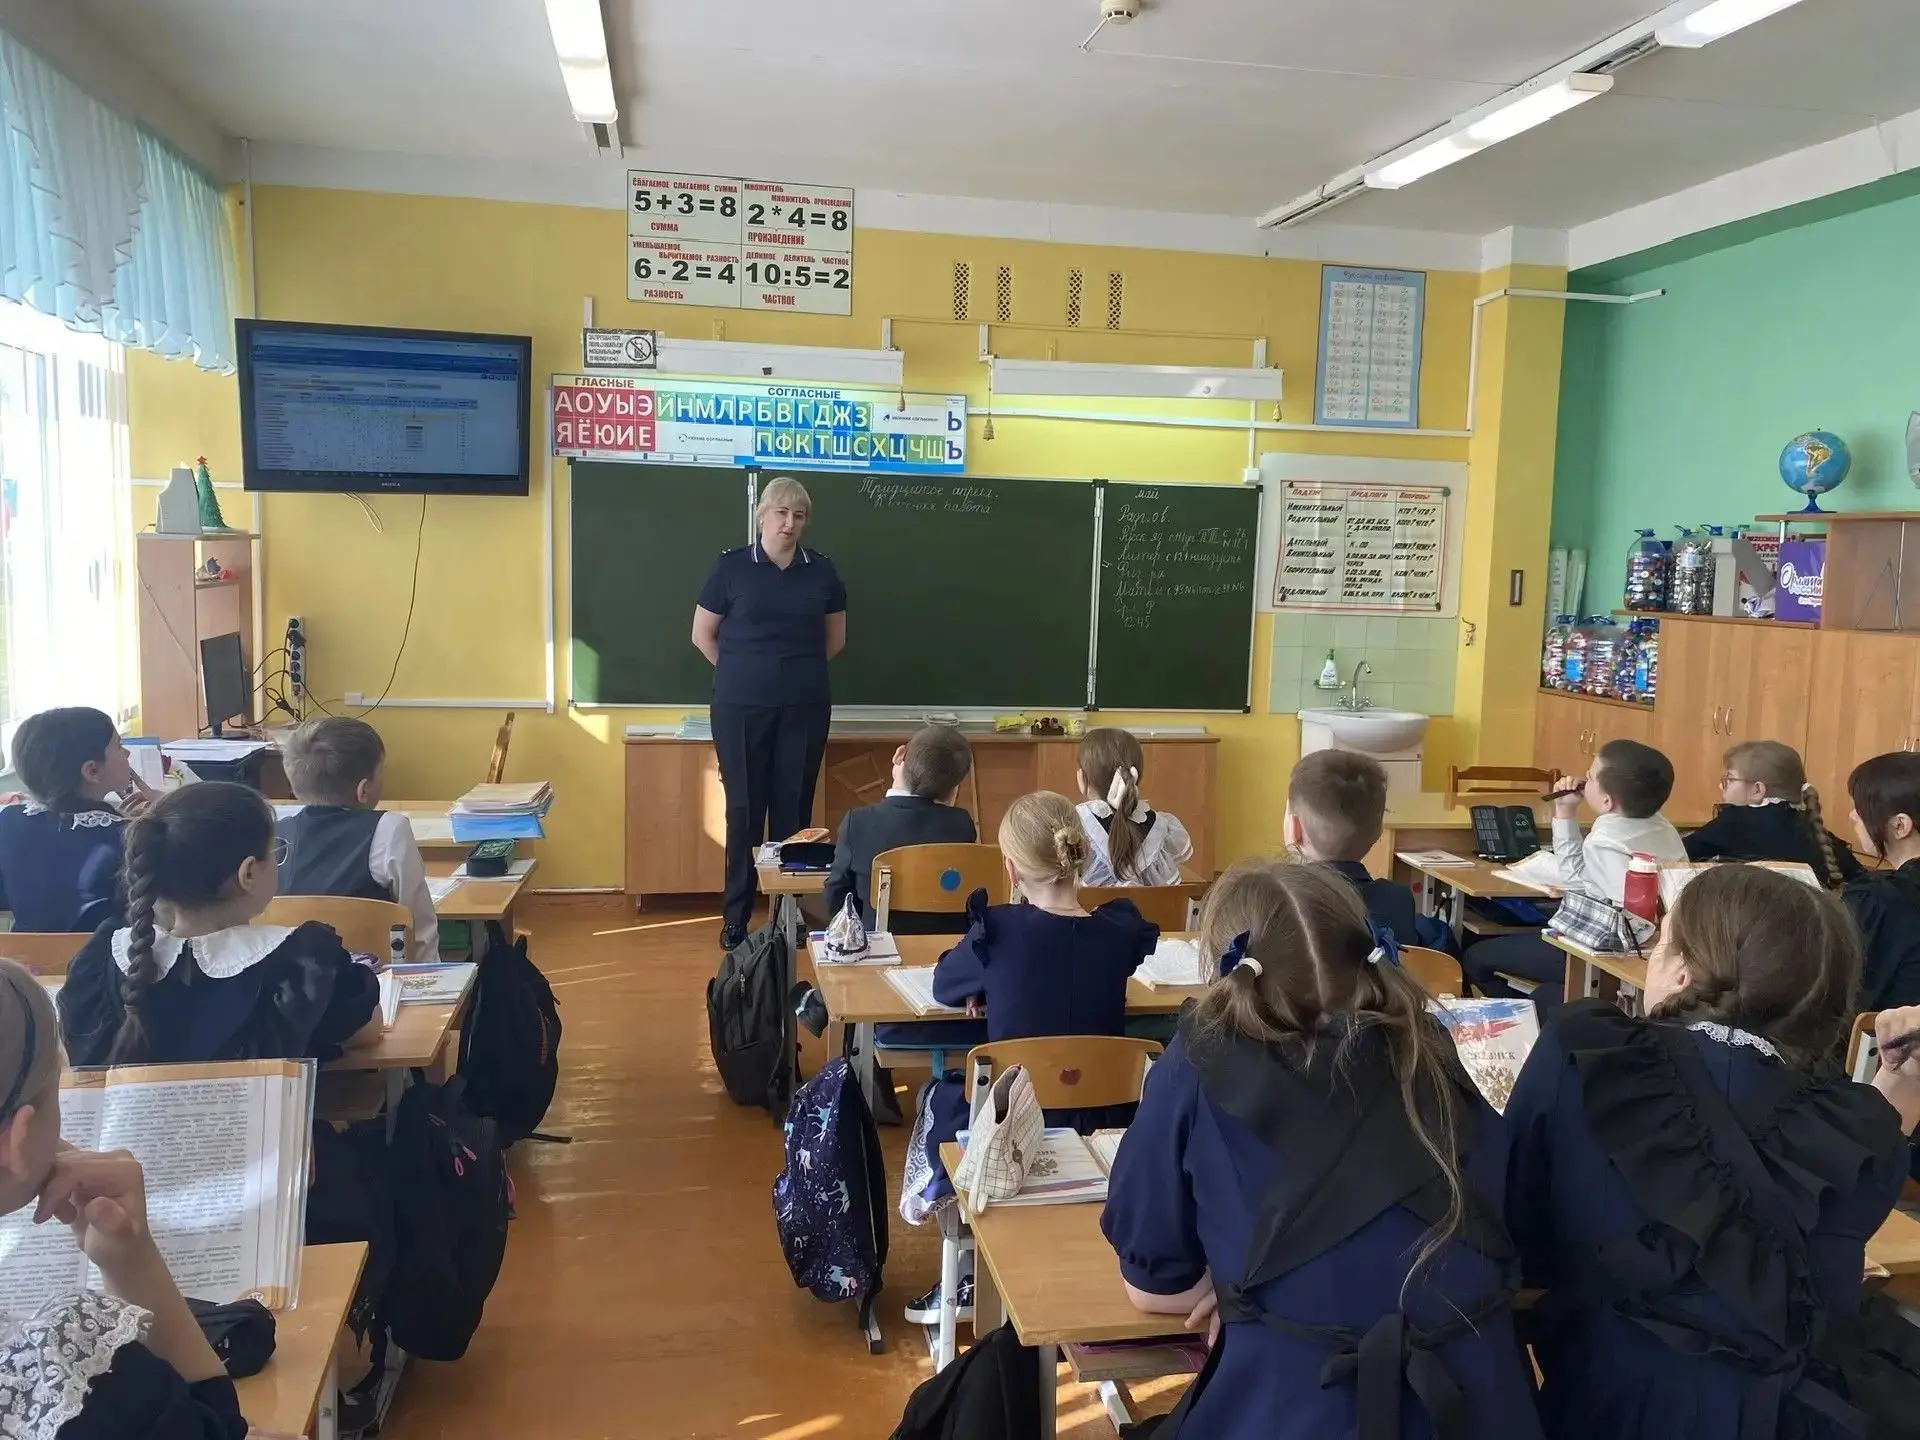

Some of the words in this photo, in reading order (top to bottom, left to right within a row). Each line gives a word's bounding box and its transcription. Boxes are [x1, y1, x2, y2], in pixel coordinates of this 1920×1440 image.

[673, 182, 710, 191] СЛАГАЕМОЕ
[714, 185, 738, 193] СУММА
[744, 183, 784, 193] МНОЖИТЕЛЬ
[771, 194, 811, 204] МНОЖИТЕЛЬ
[650, 222, 679, 233] СУММА
[747, 231, 805, 246] ПРОИЗВЕДЕНИЕ
[659, 251, 703, 262] ВЫЧИТАЕМОЕ
[706, 254, 740, 264] РАЗНОСТЬ
[746, 251, 776, 261] ДЕЛИМОЕ
[783, 254, 816, 264] ДЕЛИТЕЛЬ
[821, 256, 849, 266] ЧАСТНОЕ
[643, 289, 684, 299] РАЗНОСТЬ
[762, 293, 796, 306] ЧАСТНОЕ
[575, 377, 635, 389] ГЛАСНЫЕ
[768, 387, 841, 400] СОГЛАСНЫЕ
[947, 410, 962, 431] Ь
